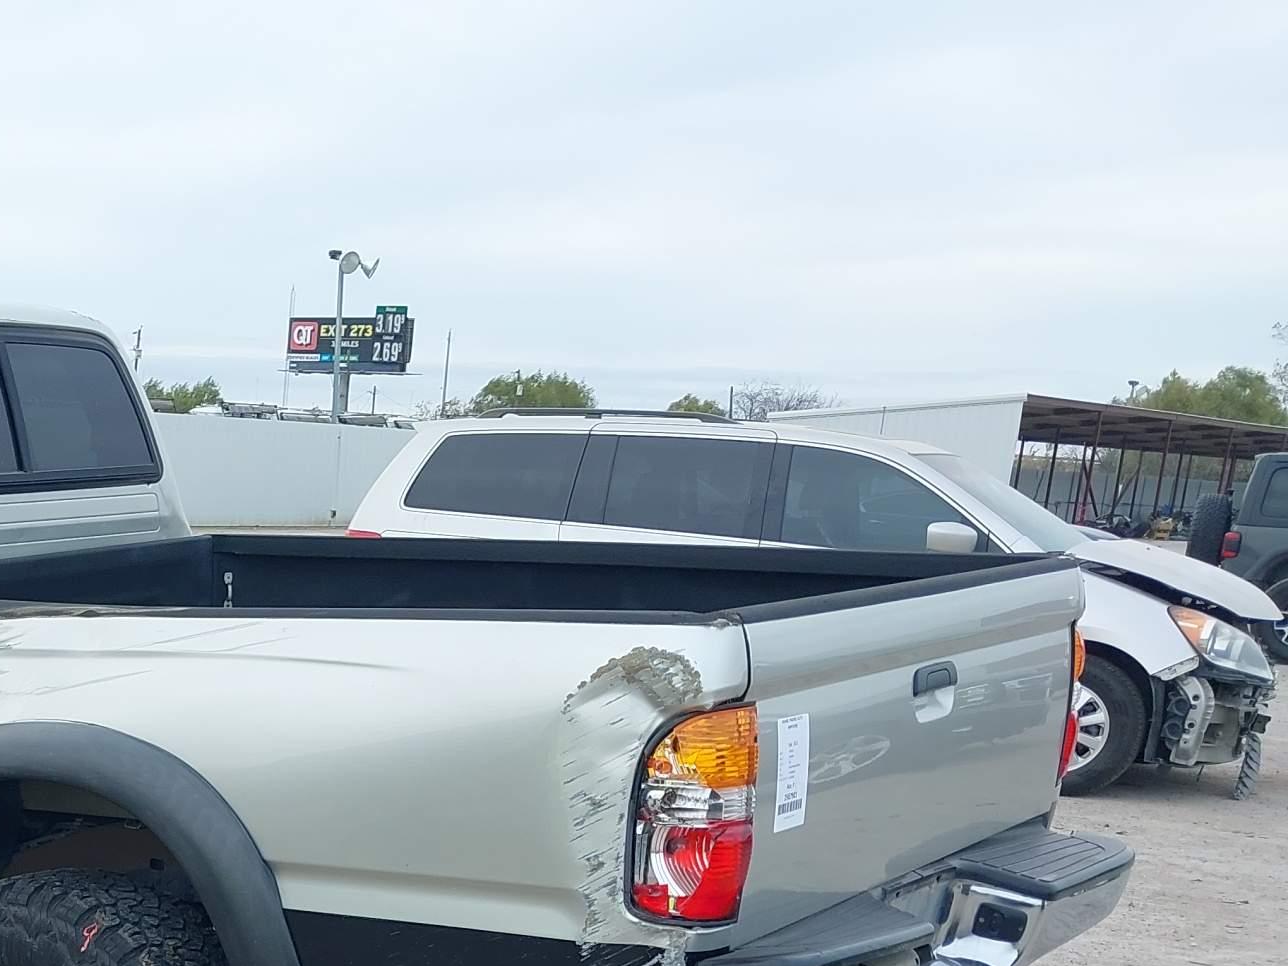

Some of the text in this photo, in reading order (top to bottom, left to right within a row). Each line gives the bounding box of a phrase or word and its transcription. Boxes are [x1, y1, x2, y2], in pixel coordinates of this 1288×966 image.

[293, 325, 314, 345] QT
[320, 324, 373, 337] EXT 273
